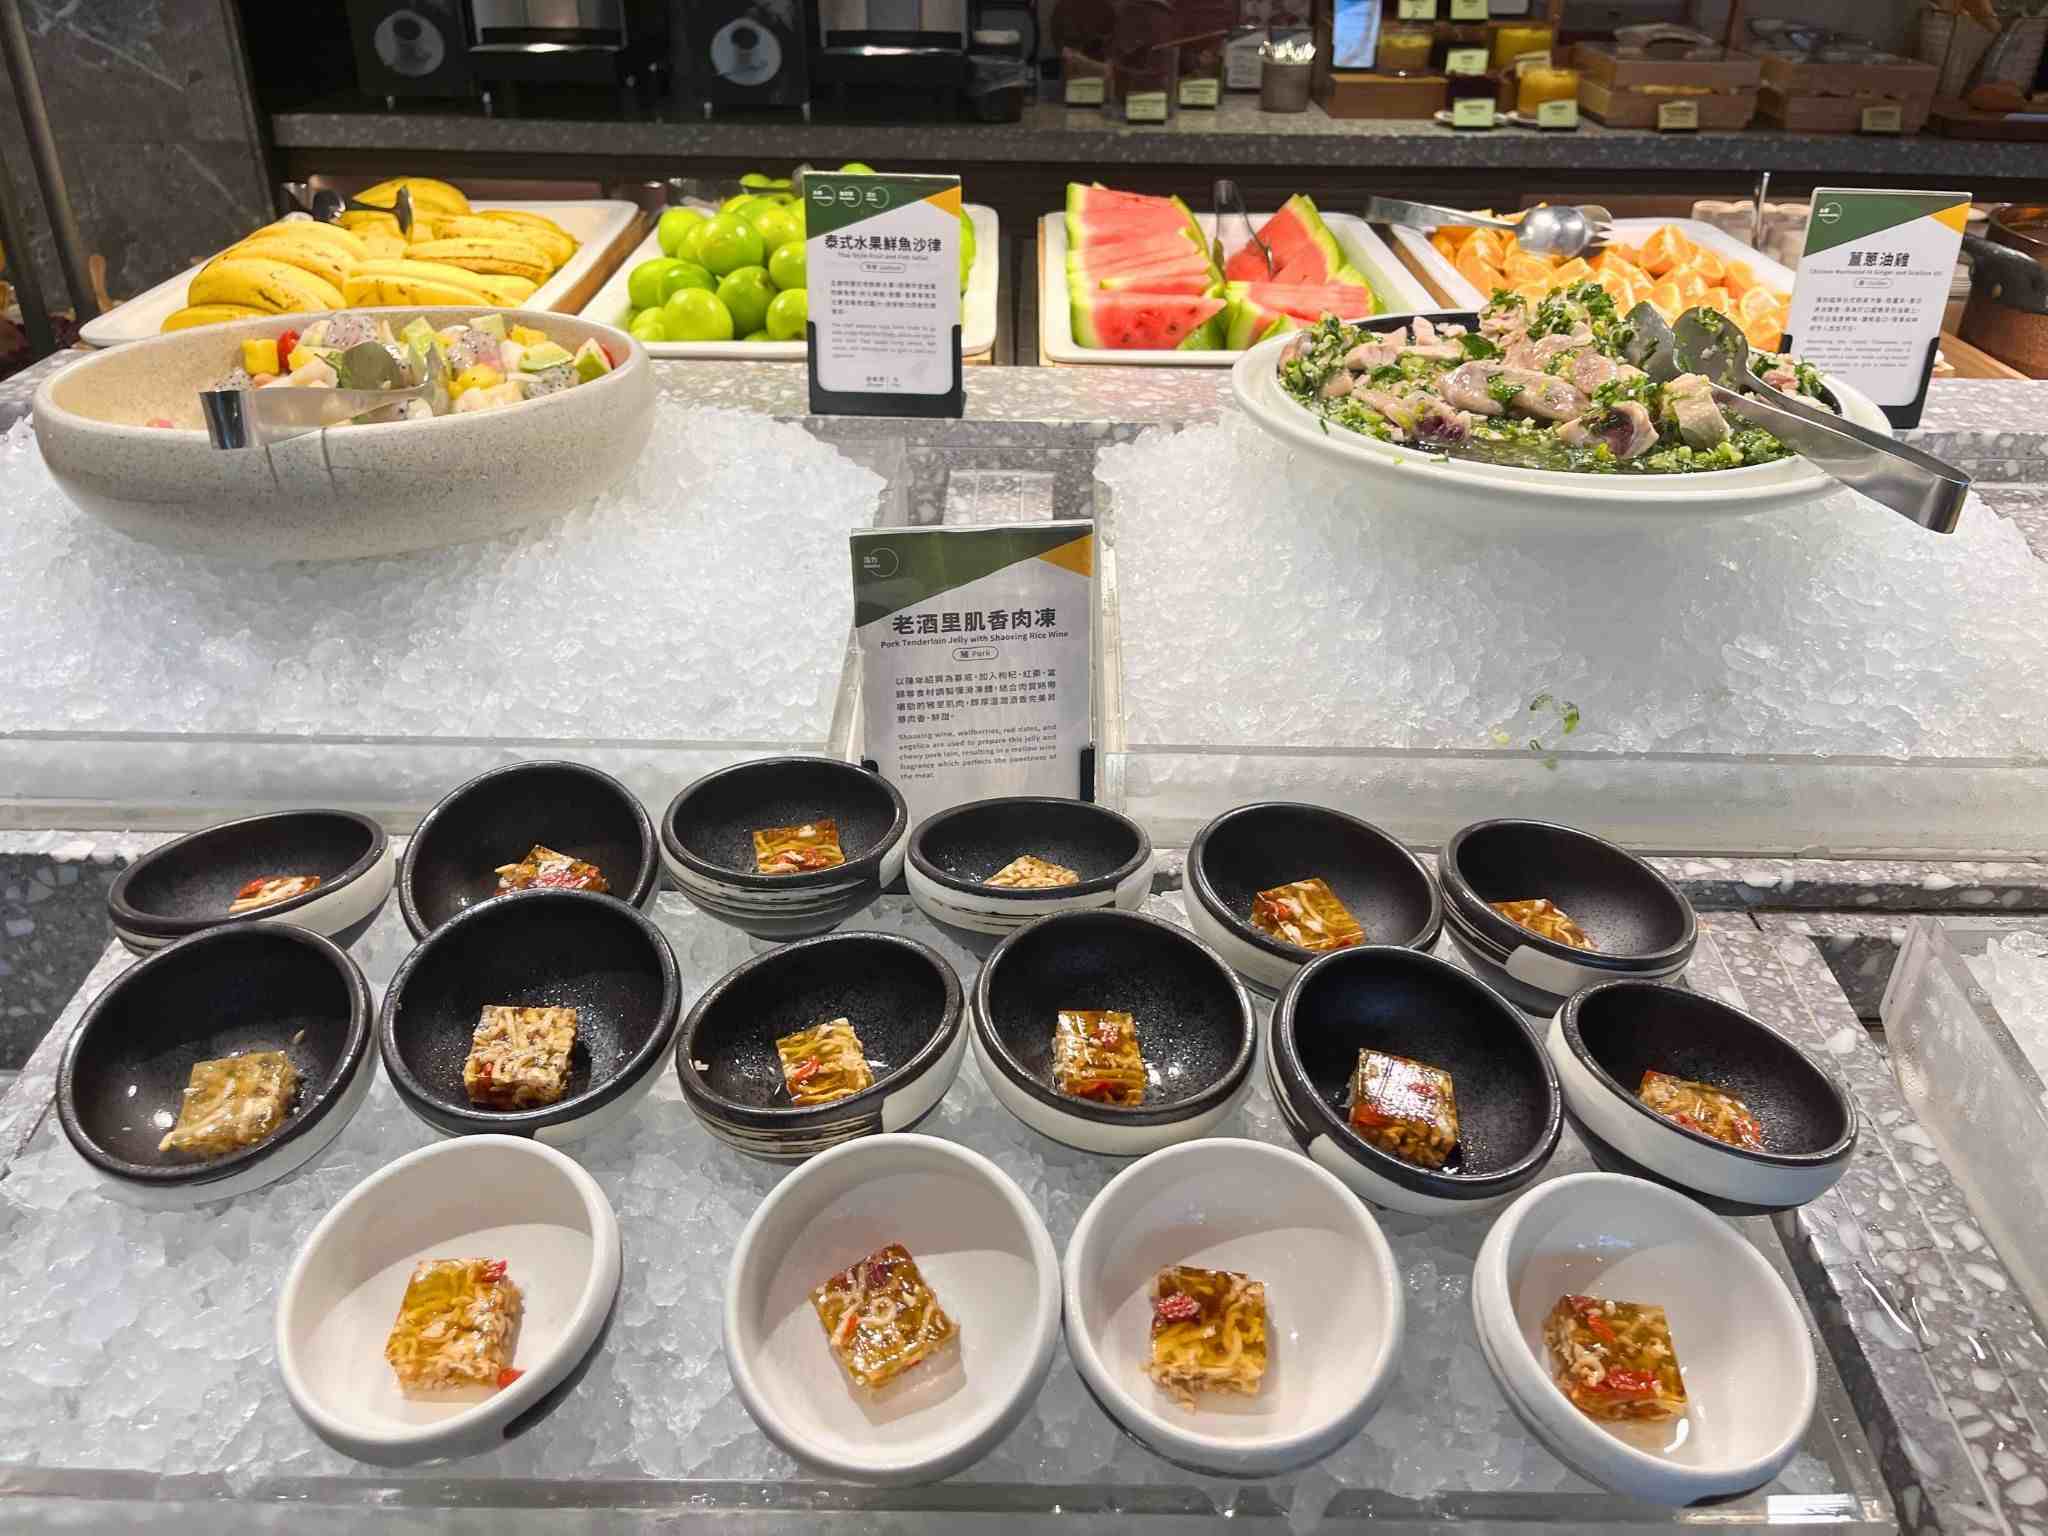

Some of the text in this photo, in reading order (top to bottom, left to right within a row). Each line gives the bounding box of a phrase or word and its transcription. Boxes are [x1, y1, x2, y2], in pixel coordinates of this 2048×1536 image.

[824, 234, 942, 252] 泰式水果鮮魚沙律
[1848, 251, 1910, 268] 薑蔥油雞
[892, 607, 1057, 635] 老酒里肌香肉凍
[880, 640, 899, 648] Pork
[901, 637, 947, 646] Tenderloin
[948, 636, 968, 645] Jelly
[970, 634, 988, 643] with
[1030, 631, 1048, 640] Rice
[1049, 630, 1068, 638] Wine
